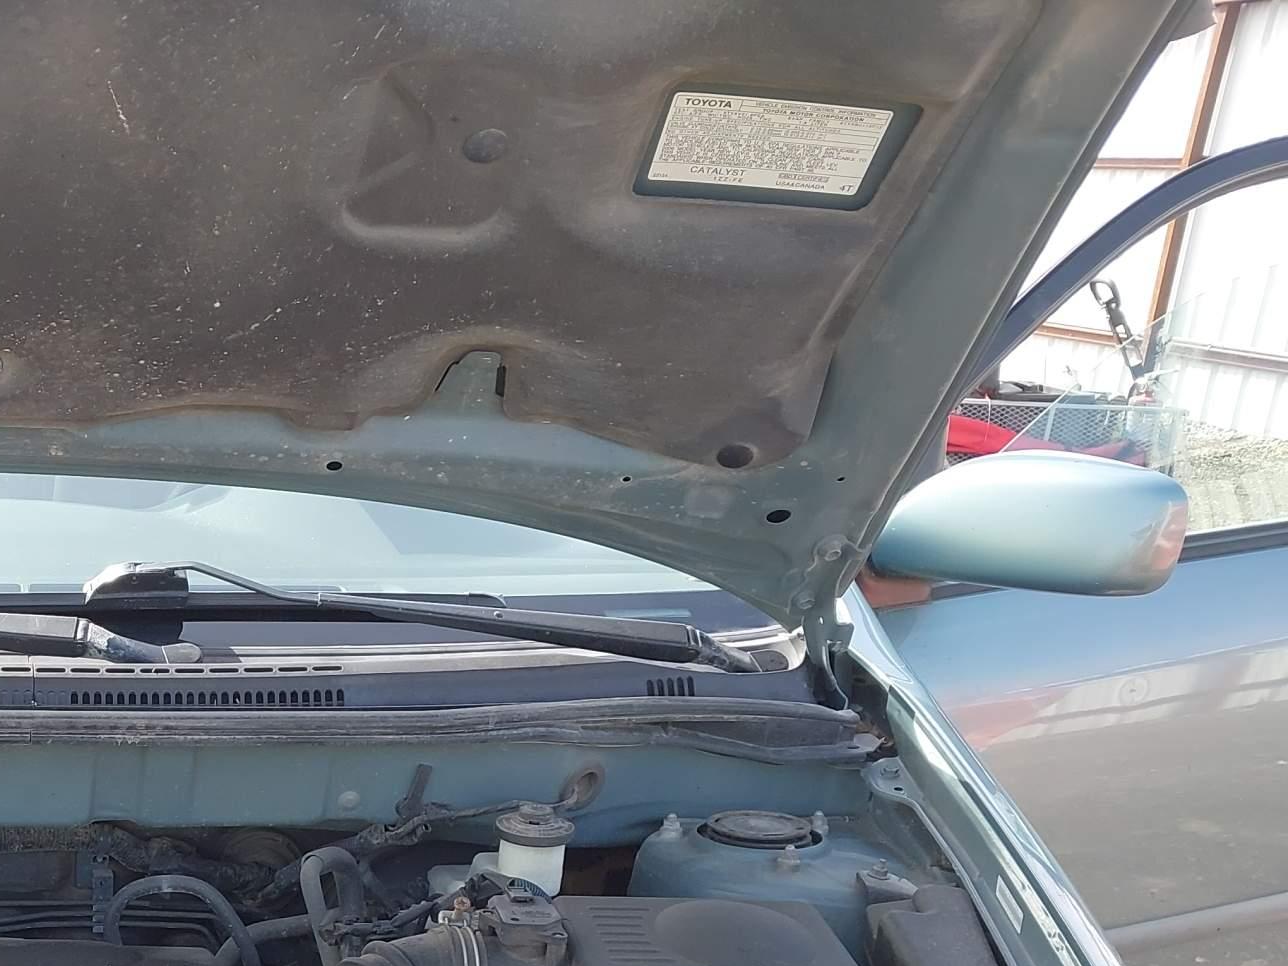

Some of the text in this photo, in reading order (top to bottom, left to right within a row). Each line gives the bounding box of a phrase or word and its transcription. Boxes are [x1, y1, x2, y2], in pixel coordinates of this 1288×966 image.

[685, 97, 732, 109] TOYOTA
[762, 107, 865, 123] TOYOTA MOTOR CORPORATION
[690, 165, 745, 177] CATALYST
[839, 184, 855, 193] 4T
